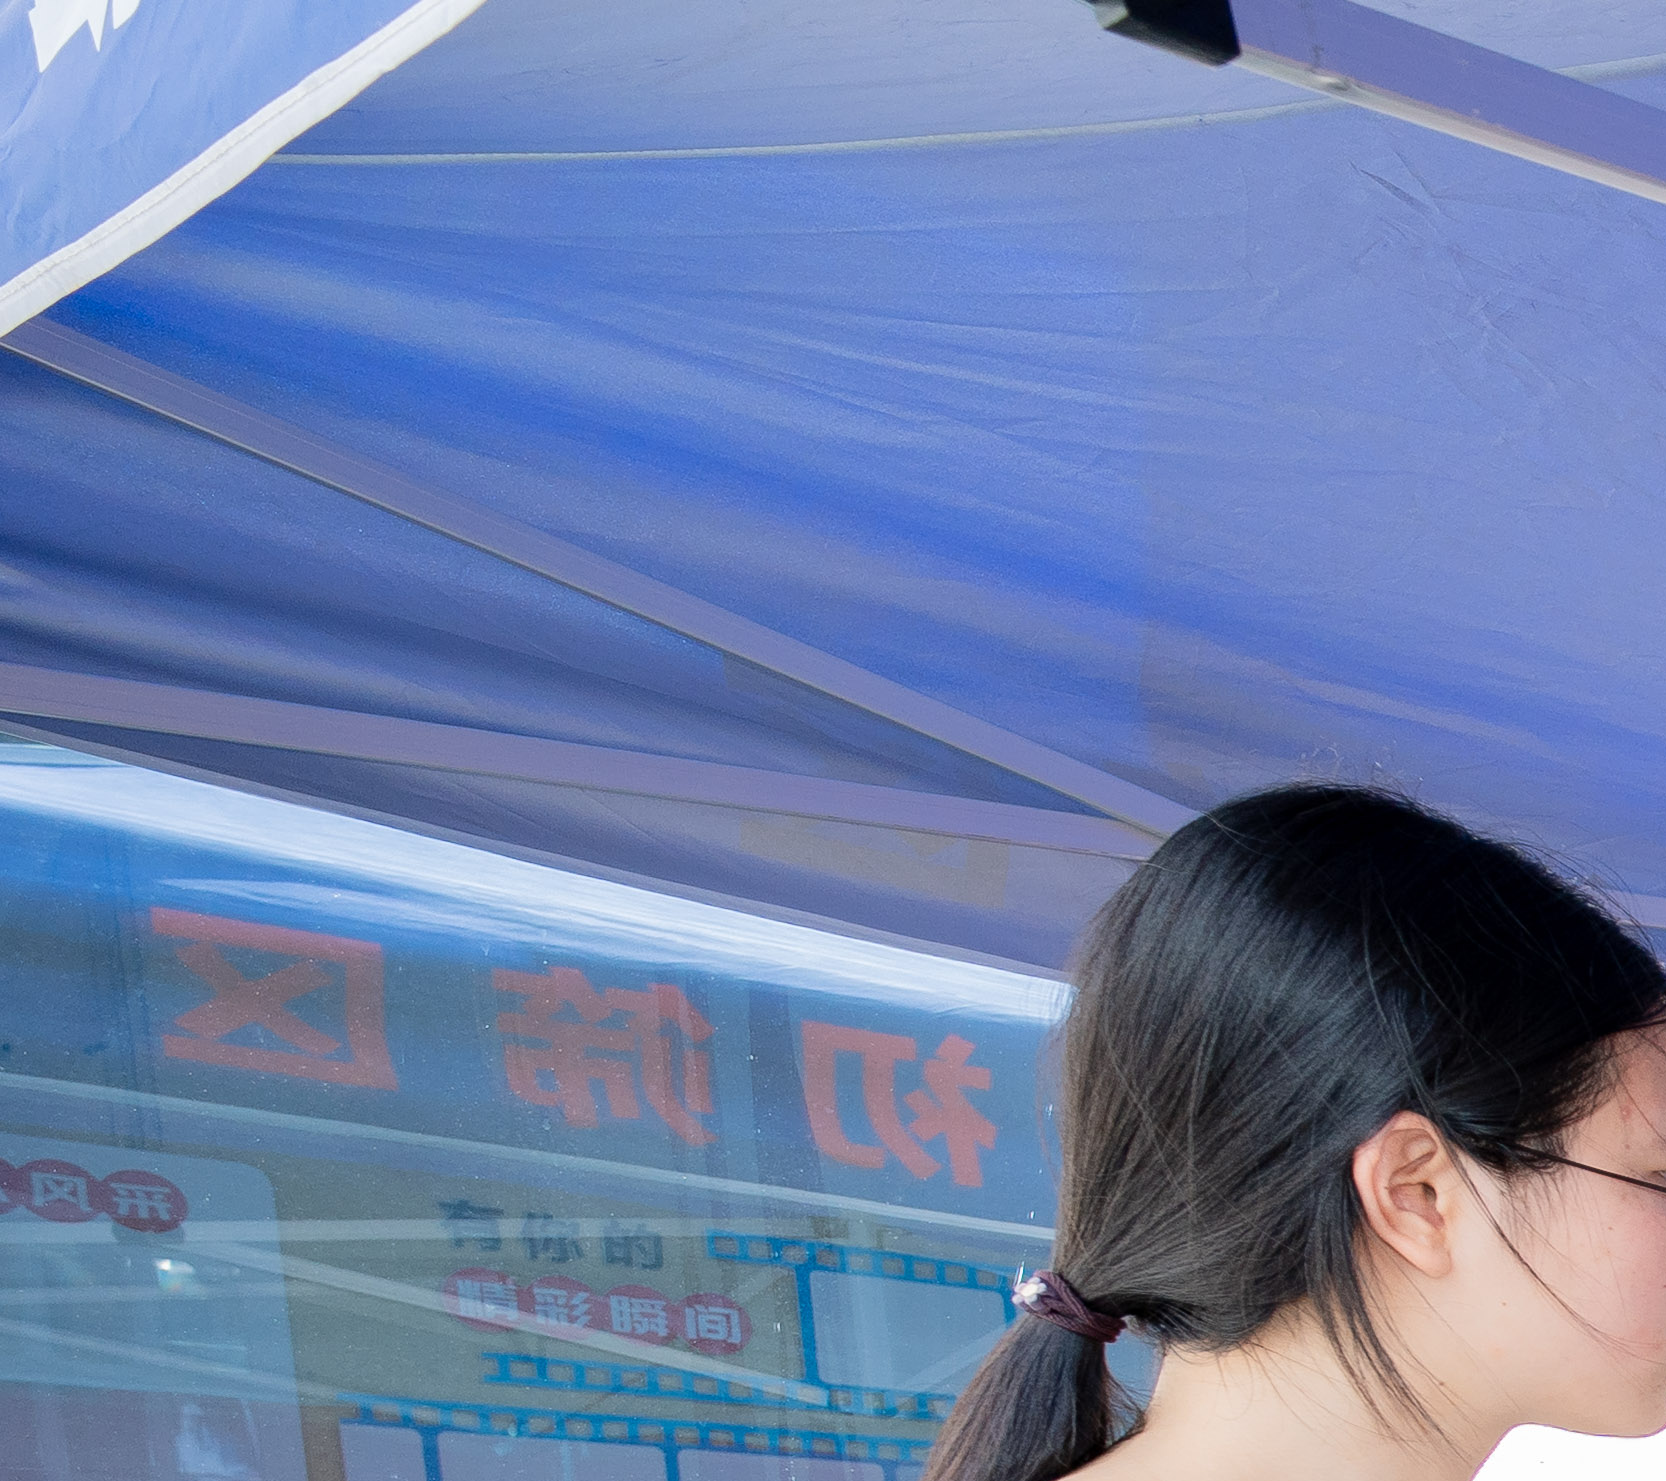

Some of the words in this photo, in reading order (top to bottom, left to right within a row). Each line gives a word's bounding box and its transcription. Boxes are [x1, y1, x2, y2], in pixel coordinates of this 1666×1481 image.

[0, 1172, 172, 1220] 风采
[457, 1278, 741, 1343] 精彩瞬间
